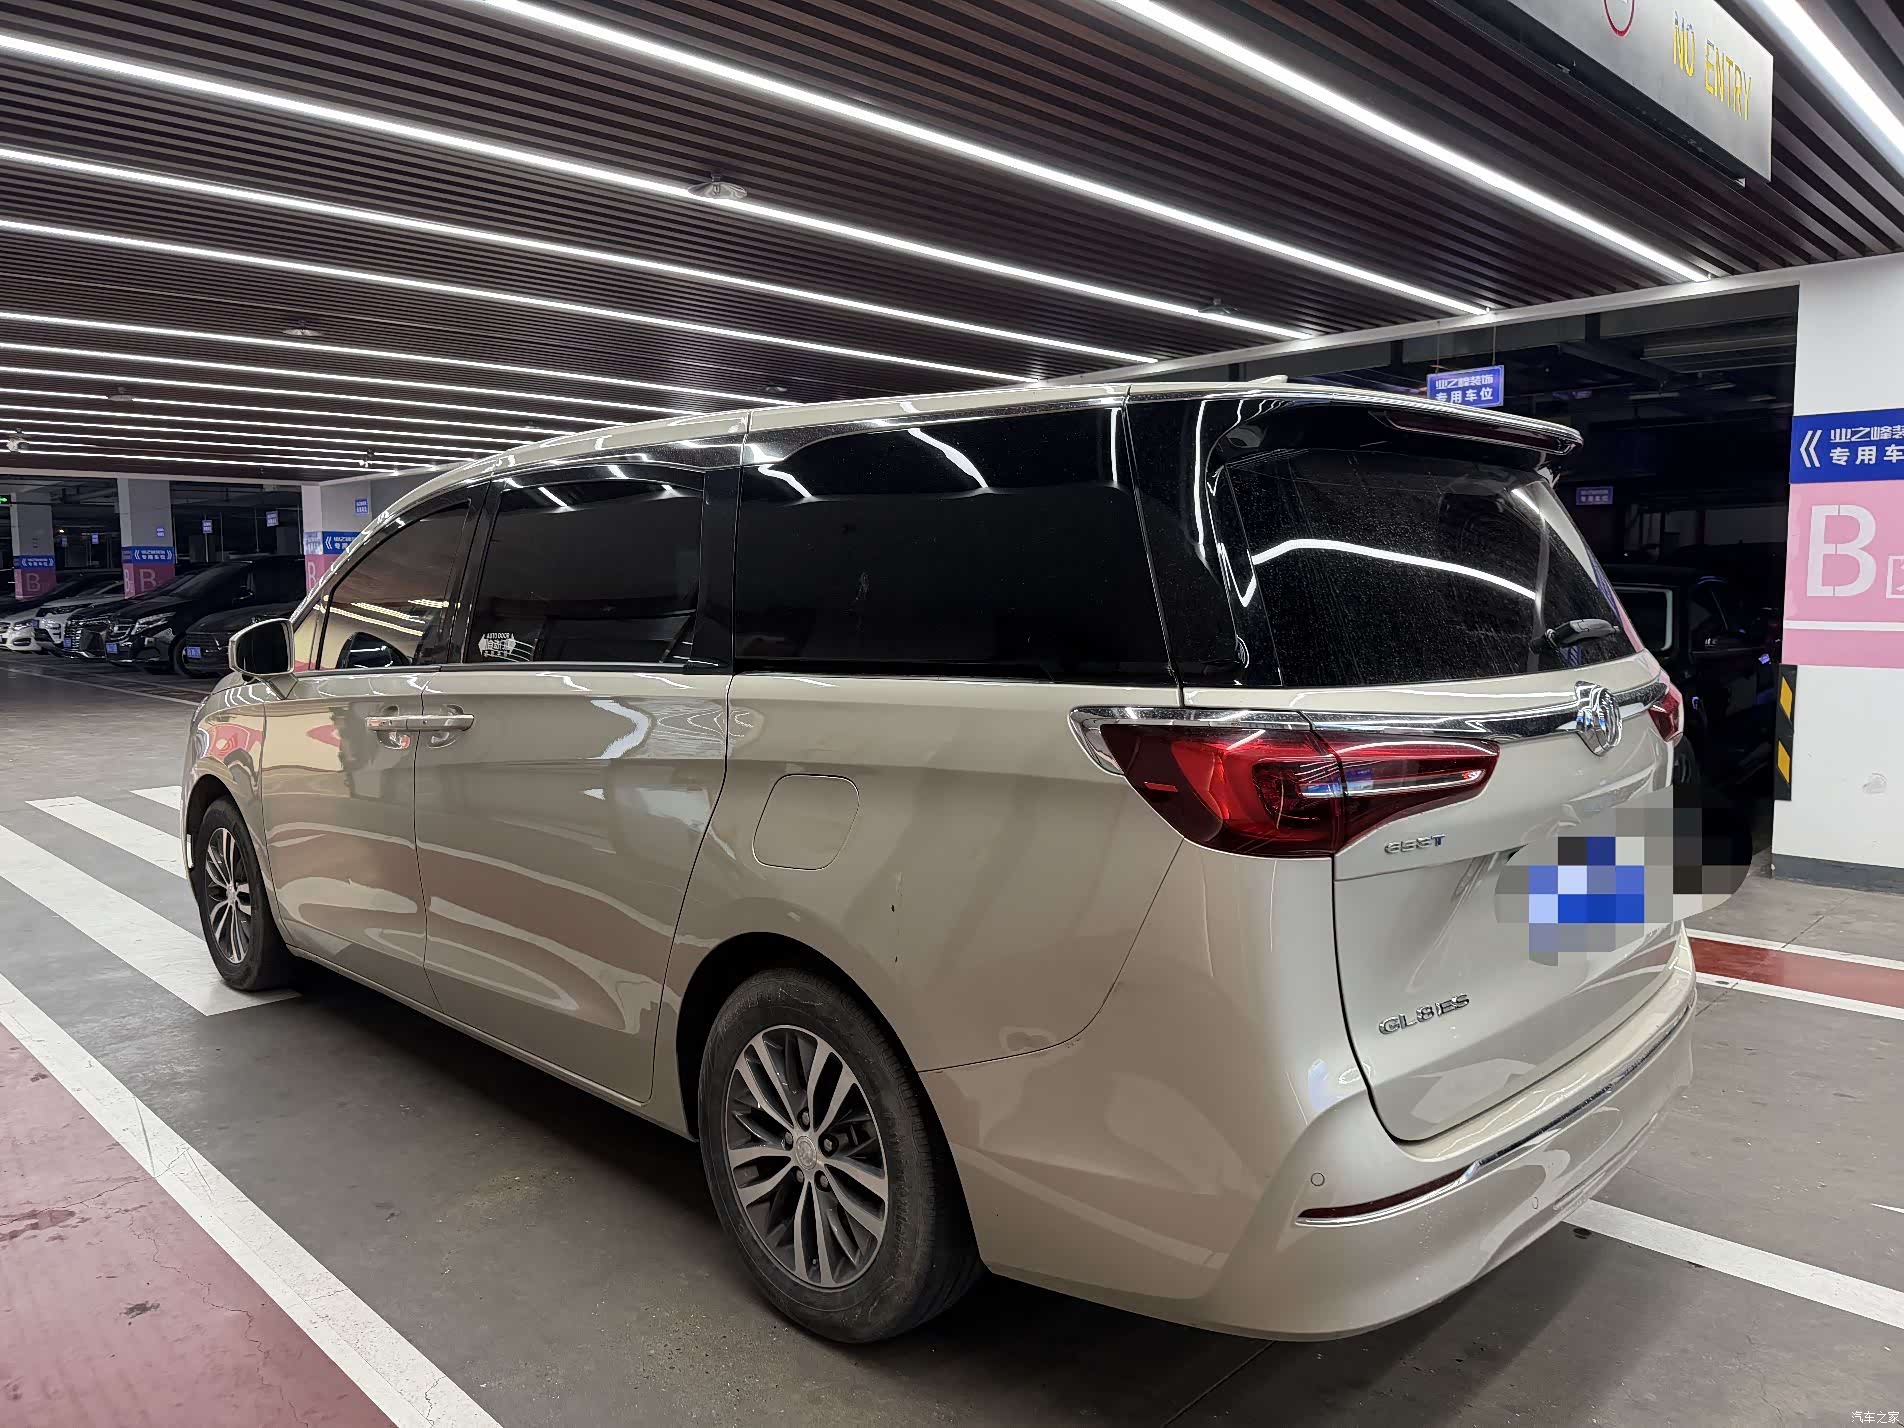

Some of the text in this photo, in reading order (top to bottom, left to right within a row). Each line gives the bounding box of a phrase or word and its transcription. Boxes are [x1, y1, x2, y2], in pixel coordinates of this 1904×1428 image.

[1673, 11, 1751, 120] NO ENTRY
[1434, 387, 1494, 404] 专用车位
